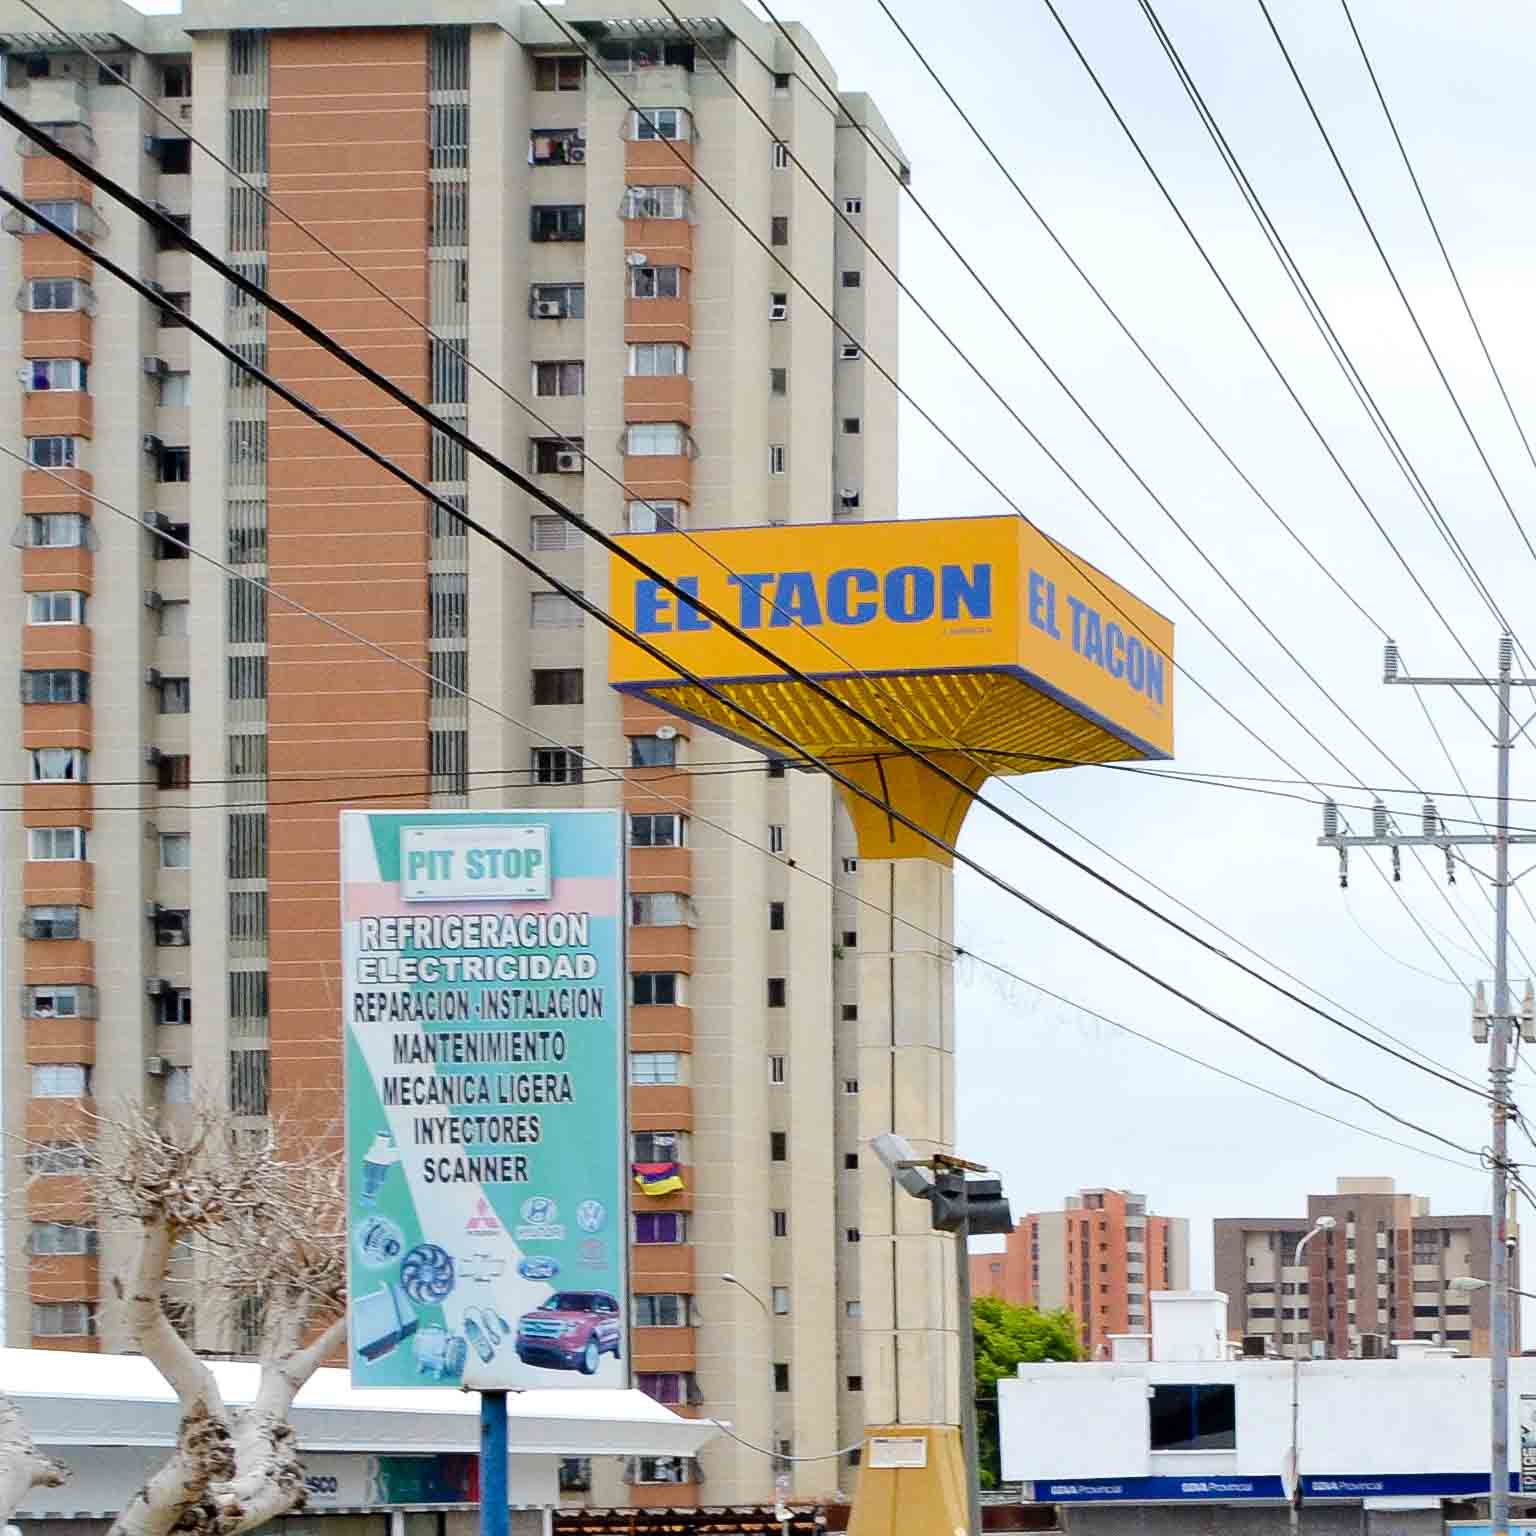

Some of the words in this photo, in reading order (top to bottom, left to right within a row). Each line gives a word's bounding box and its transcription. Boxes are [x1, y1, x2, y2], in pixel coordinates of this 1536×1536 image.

[634, 576, 716, 634] EL
[728, 562, 992, 630] TACON
[1028, 568, 1062, 641] EL
[1066, 596, 1164, 705] TACON
[408, 849, 453, 881] PIT
[465, 848, 542, 880] STOP
[359, 912, 589, 951] REFRIGERACION
[358, 953, 597, 984] ELECTRICIDAD
[353, 991, 468, 1023] REPARACION
[393, 1031, 567, 1064] MANTENIMIENTO
[383, 1074, 491, 1105] MECANICA
[496, 1072, 573, 1103] LIGERA
[414, 1115, 540, 1144] INYECTORES
[423, 1156, 528, 1183] SCANNER
